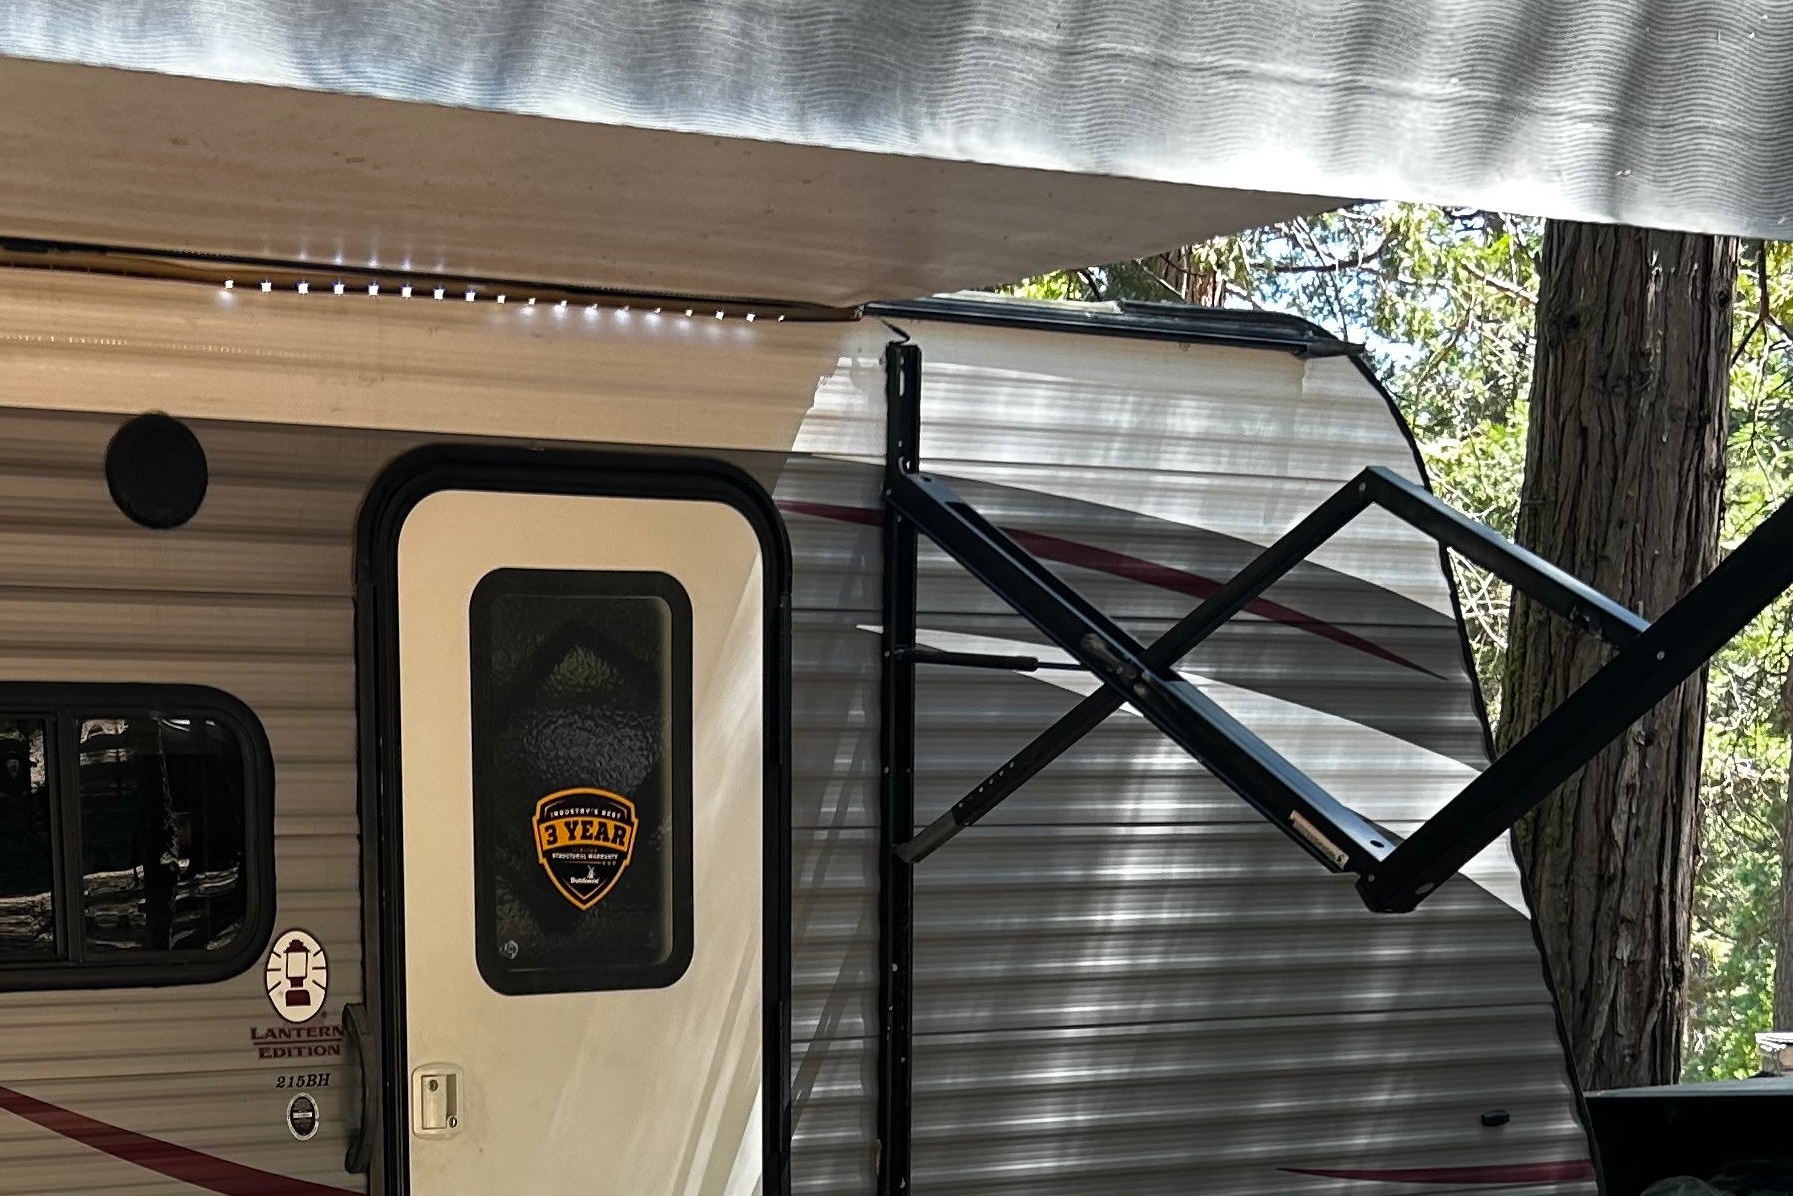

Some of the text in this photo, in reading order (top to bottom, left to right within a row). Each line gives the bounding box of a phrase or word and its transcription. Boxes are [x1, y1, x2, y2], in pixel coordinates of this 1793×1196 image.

[544, 819, 627, 847] 3 YEAR
[250, 1024, 345, 1041] LANTERN
[258, 1043, 341, 1060] EDITION
[275, 1072, 332, 1089] 215BH
